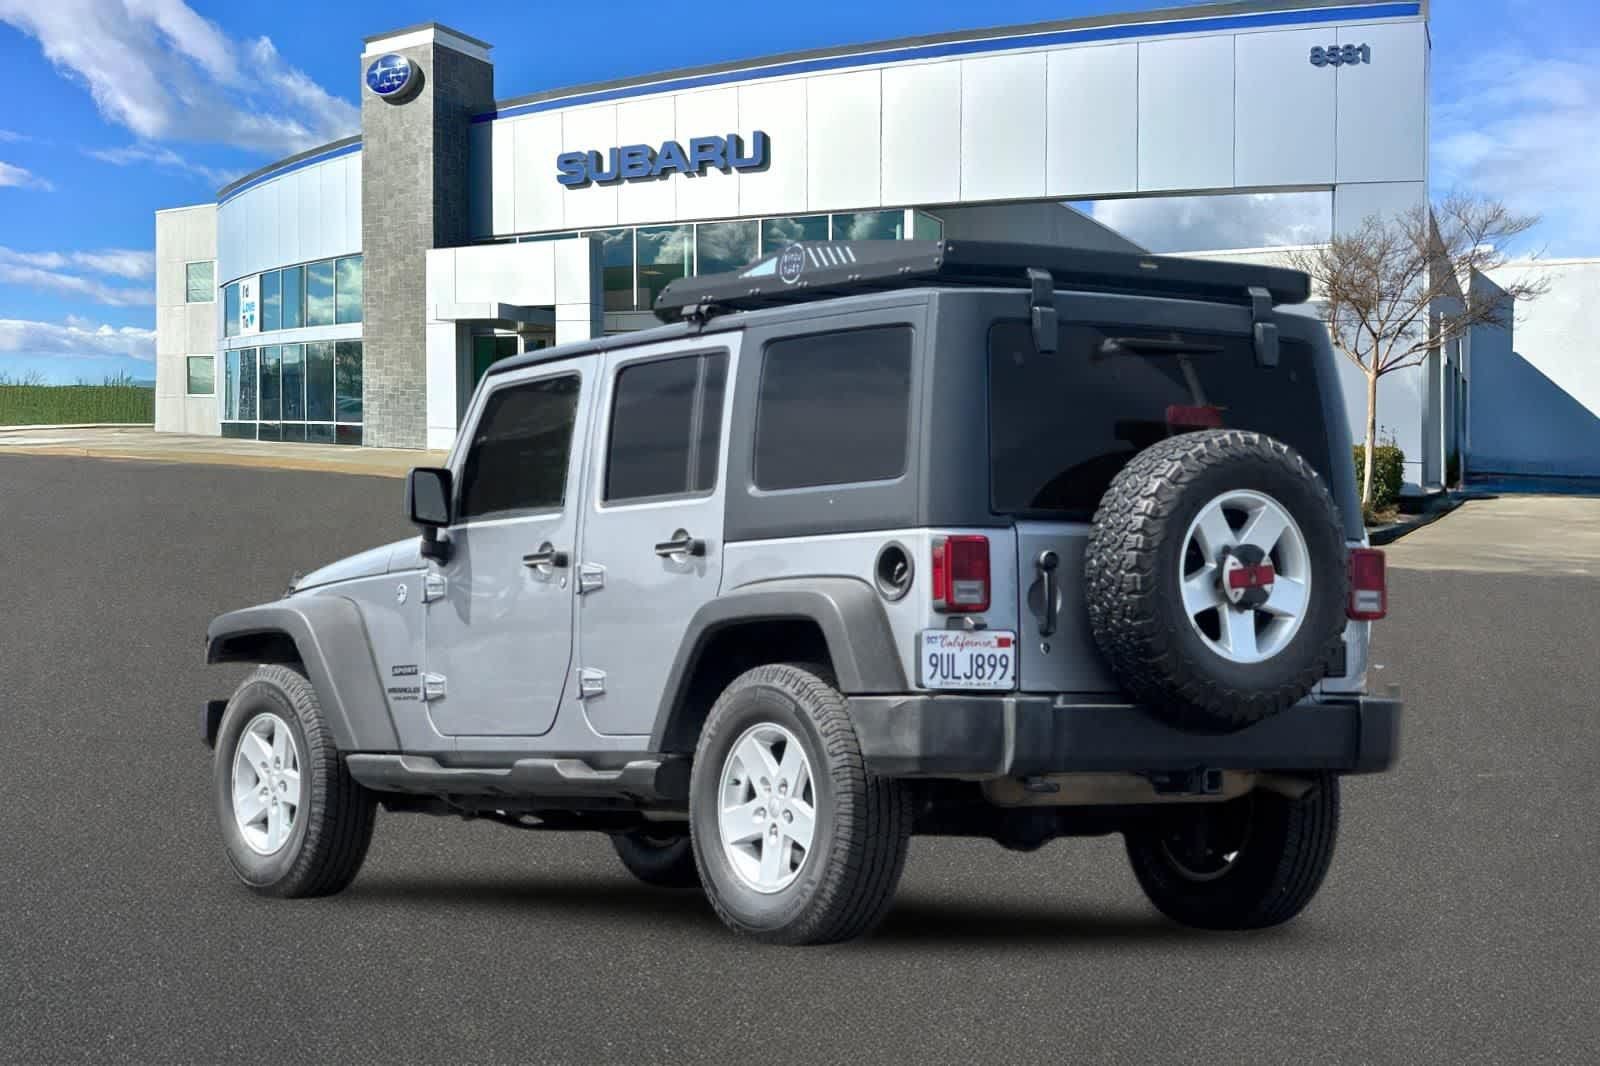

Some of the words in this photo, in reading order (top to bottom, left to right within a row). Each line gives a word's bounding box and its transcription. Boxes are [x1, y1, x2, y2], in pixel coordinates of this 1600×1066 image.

[556, 130, 771, 190] SUBARU
[940, 634, 993, 652] California
[928, 652, 1009, 681] 9ULJ899
